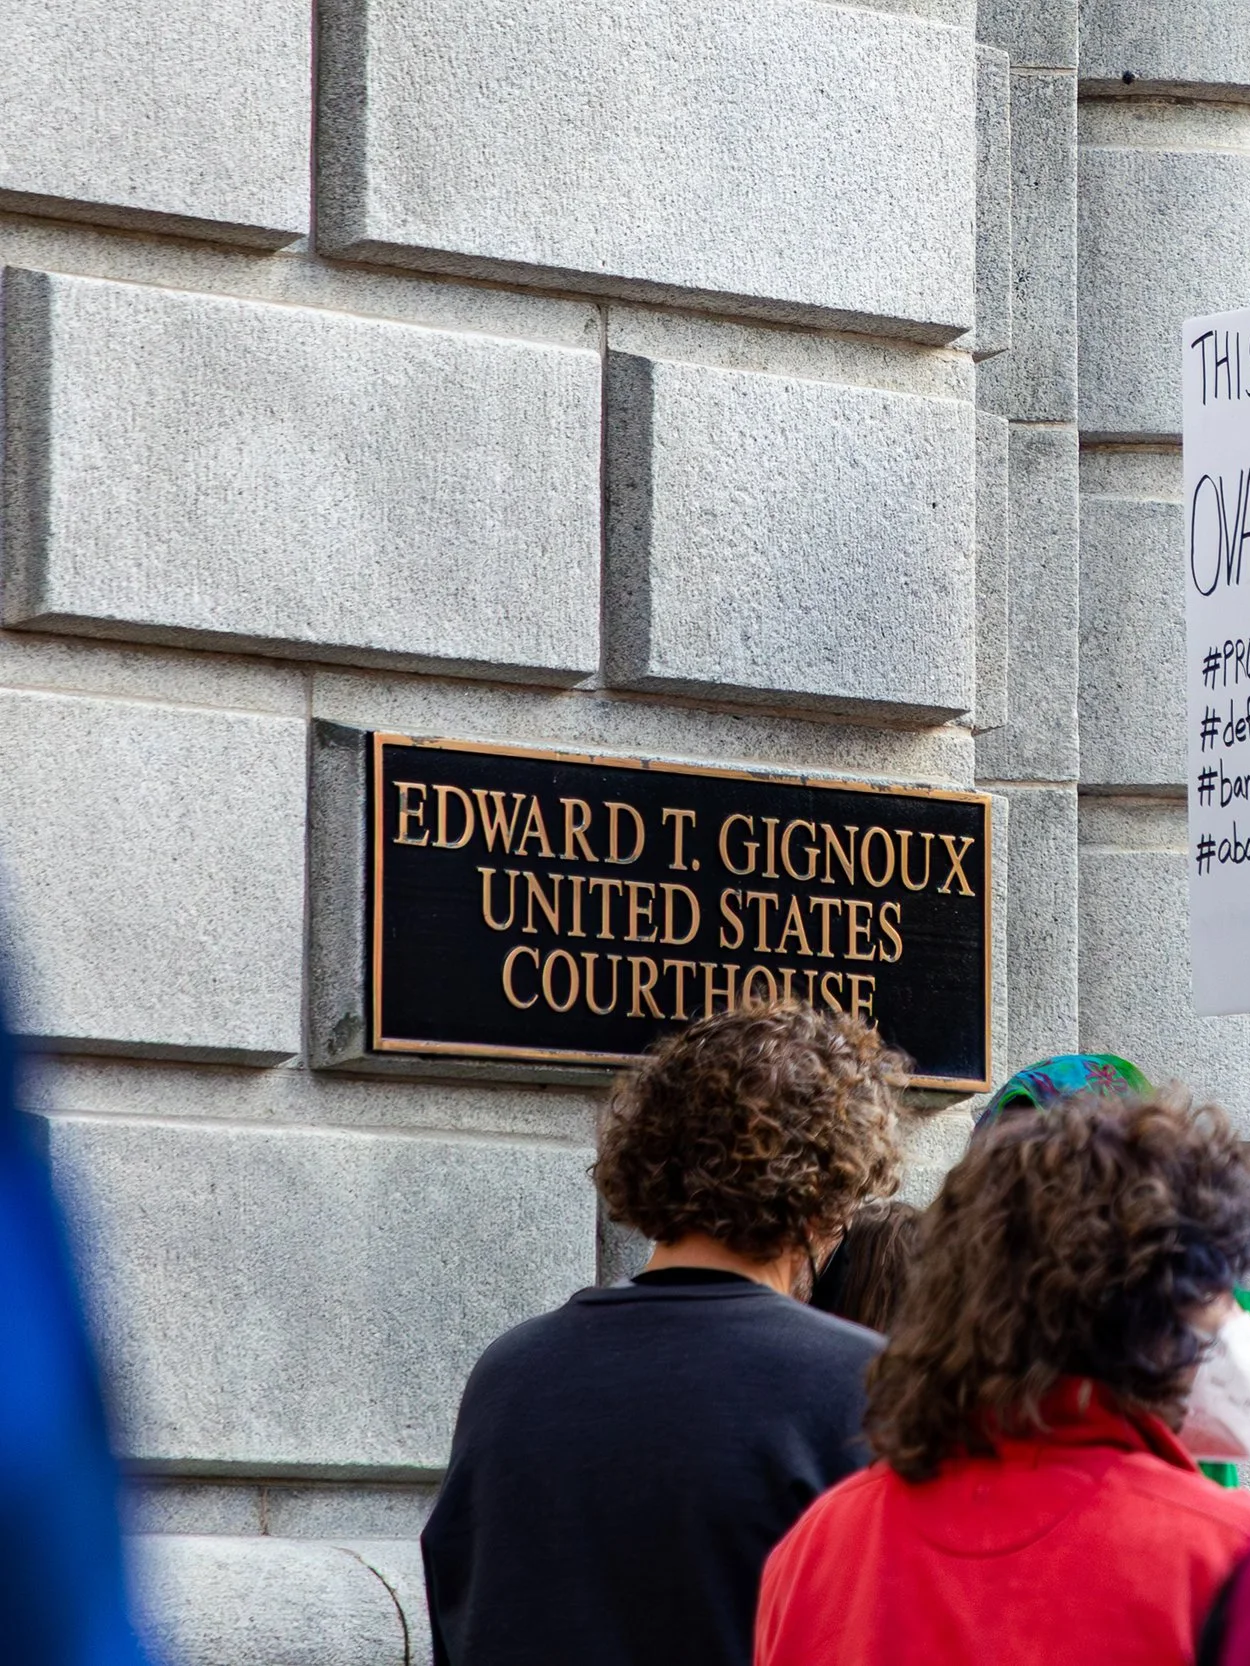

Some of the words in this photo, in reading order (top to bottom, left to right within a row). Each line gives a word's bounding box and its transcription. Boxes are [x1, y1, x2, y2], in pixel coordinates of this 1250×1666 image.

[393, 780, 646, 866] EDWARD
[662, 807, 701, 872] T.
[719, 813, 976, 898] GIGNOUX
[477, 866, 701, 946] UNITED
[719, 887, 903, 963] STATES
[502, 945, 878, 1022] COURTHOUSE
